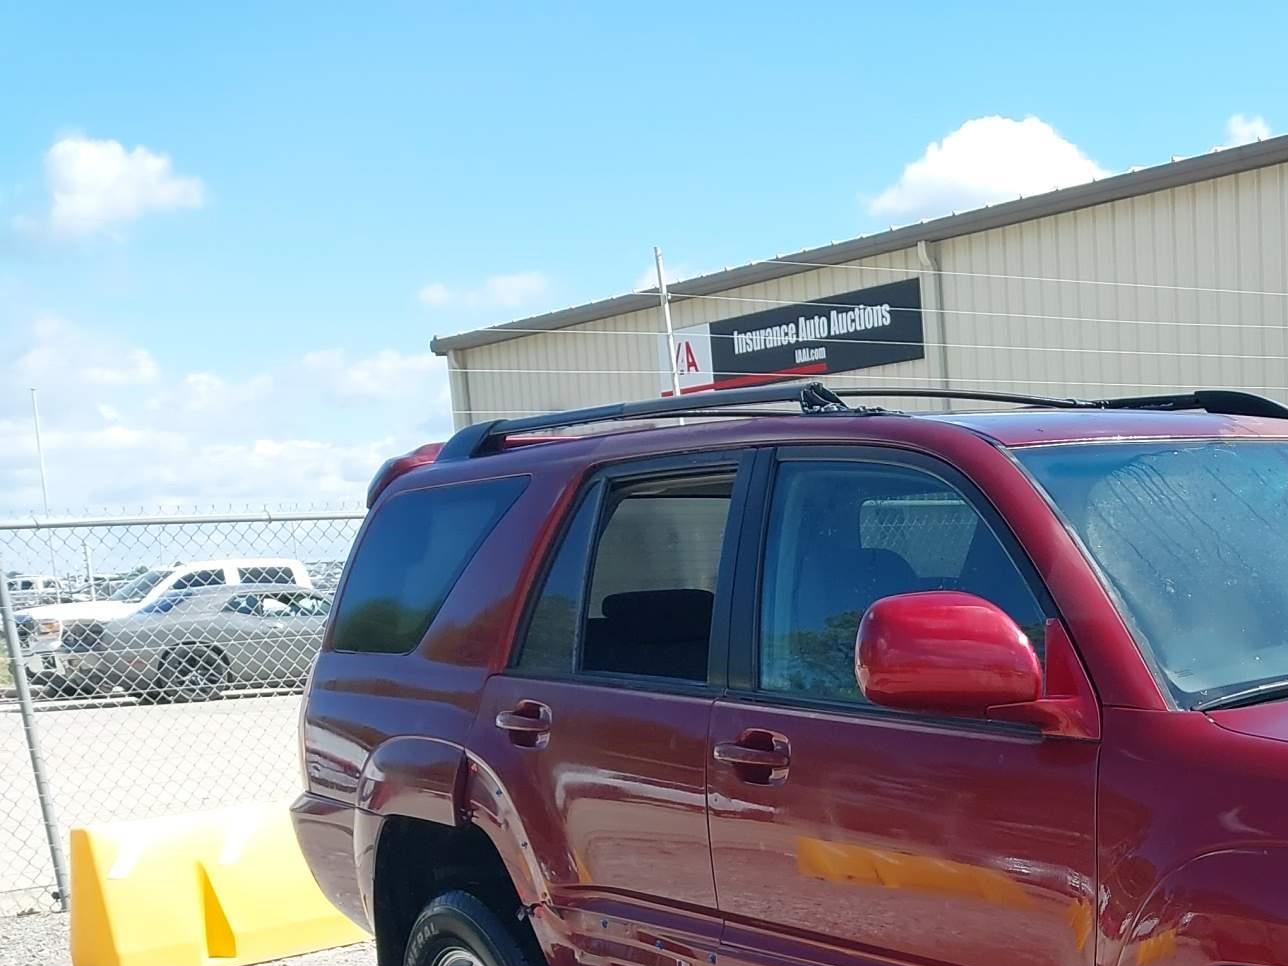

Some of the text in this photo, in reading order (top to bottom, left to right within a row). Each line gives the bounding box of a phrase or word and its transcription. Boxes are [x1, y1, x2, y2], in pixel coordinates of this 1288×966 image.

[733, 303, 891, 355] Insurance Auto Auctions
